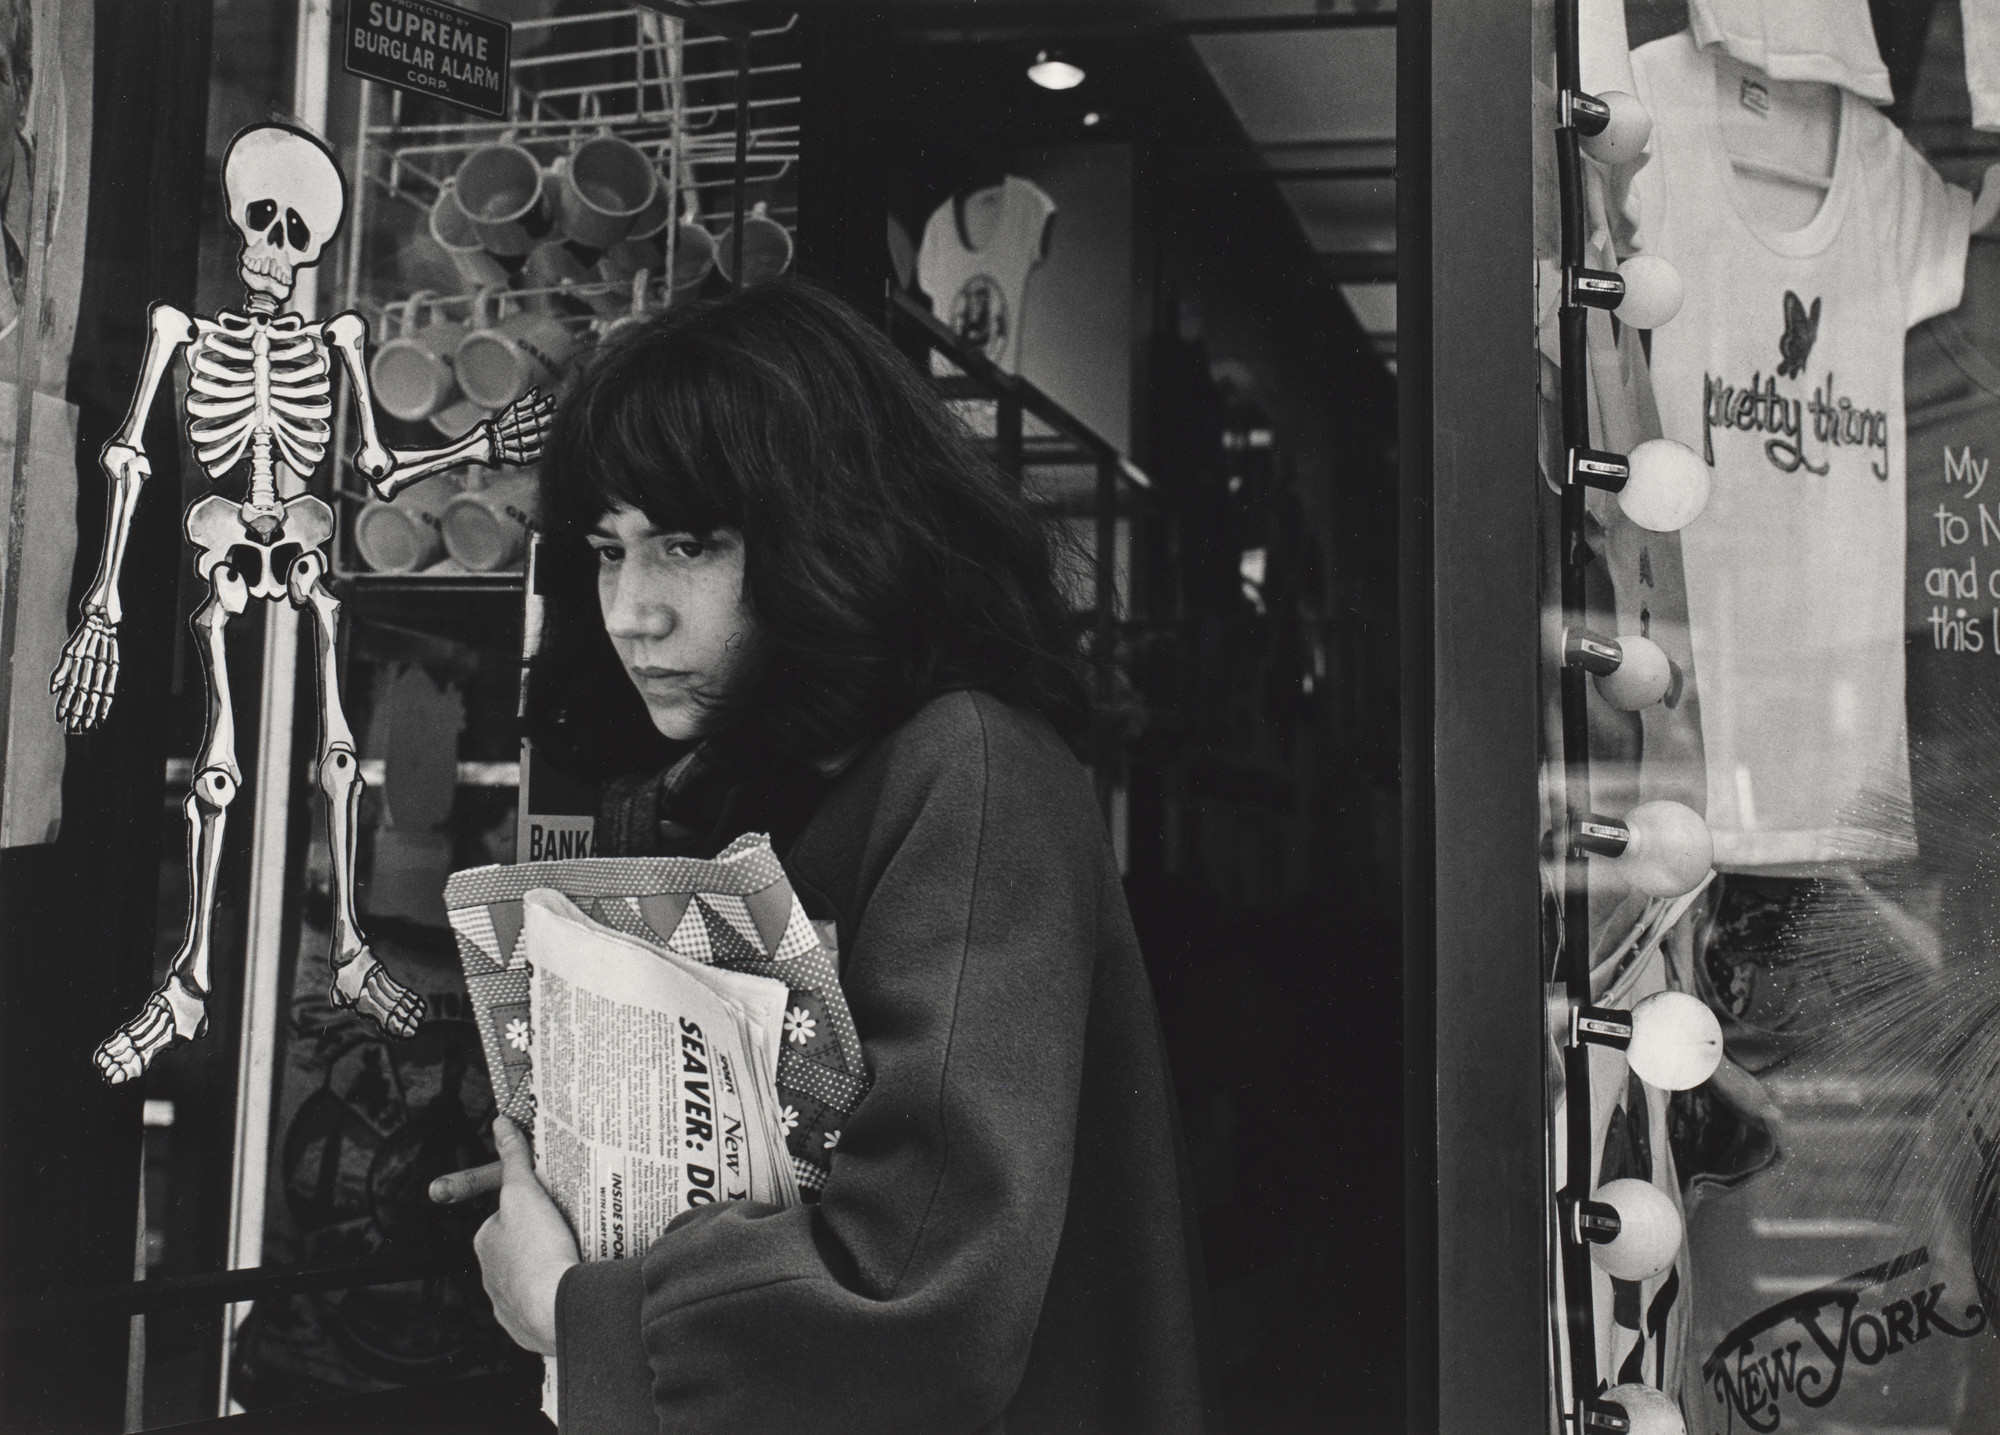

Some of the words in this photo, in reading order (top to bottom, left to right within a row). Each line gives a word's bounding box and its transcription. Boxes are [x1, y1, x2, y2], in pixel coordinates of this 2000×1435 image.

[369, 1, 488, 62] SUPREME
[456, 16, 470, 27] BY
[354, 27, 435, 71] BURGLAR
[440, 56, 500, 91] ALARM
[407, 70, 450, 92] CORP.
[1703, 370, 1830, 476] pretty
[1808, 371, 1888, 481] thing
[1944, 445, 1989, 498] My
[1933, 503, 1969, 547] to
[1925, 556, 1978, 600] and
[1927, 606, 1984, 652] this
[679, 1016, 713, 1152] SEAVER:
[723, 1112, 742, 1177] New
[599, 1186, 607, 1209] WITH
[611, 1173, 623, 1220] INSIDE
[1714, 1340, 1801, 1435] NEW
[1797, 1283, 1986, 1407] YORK
